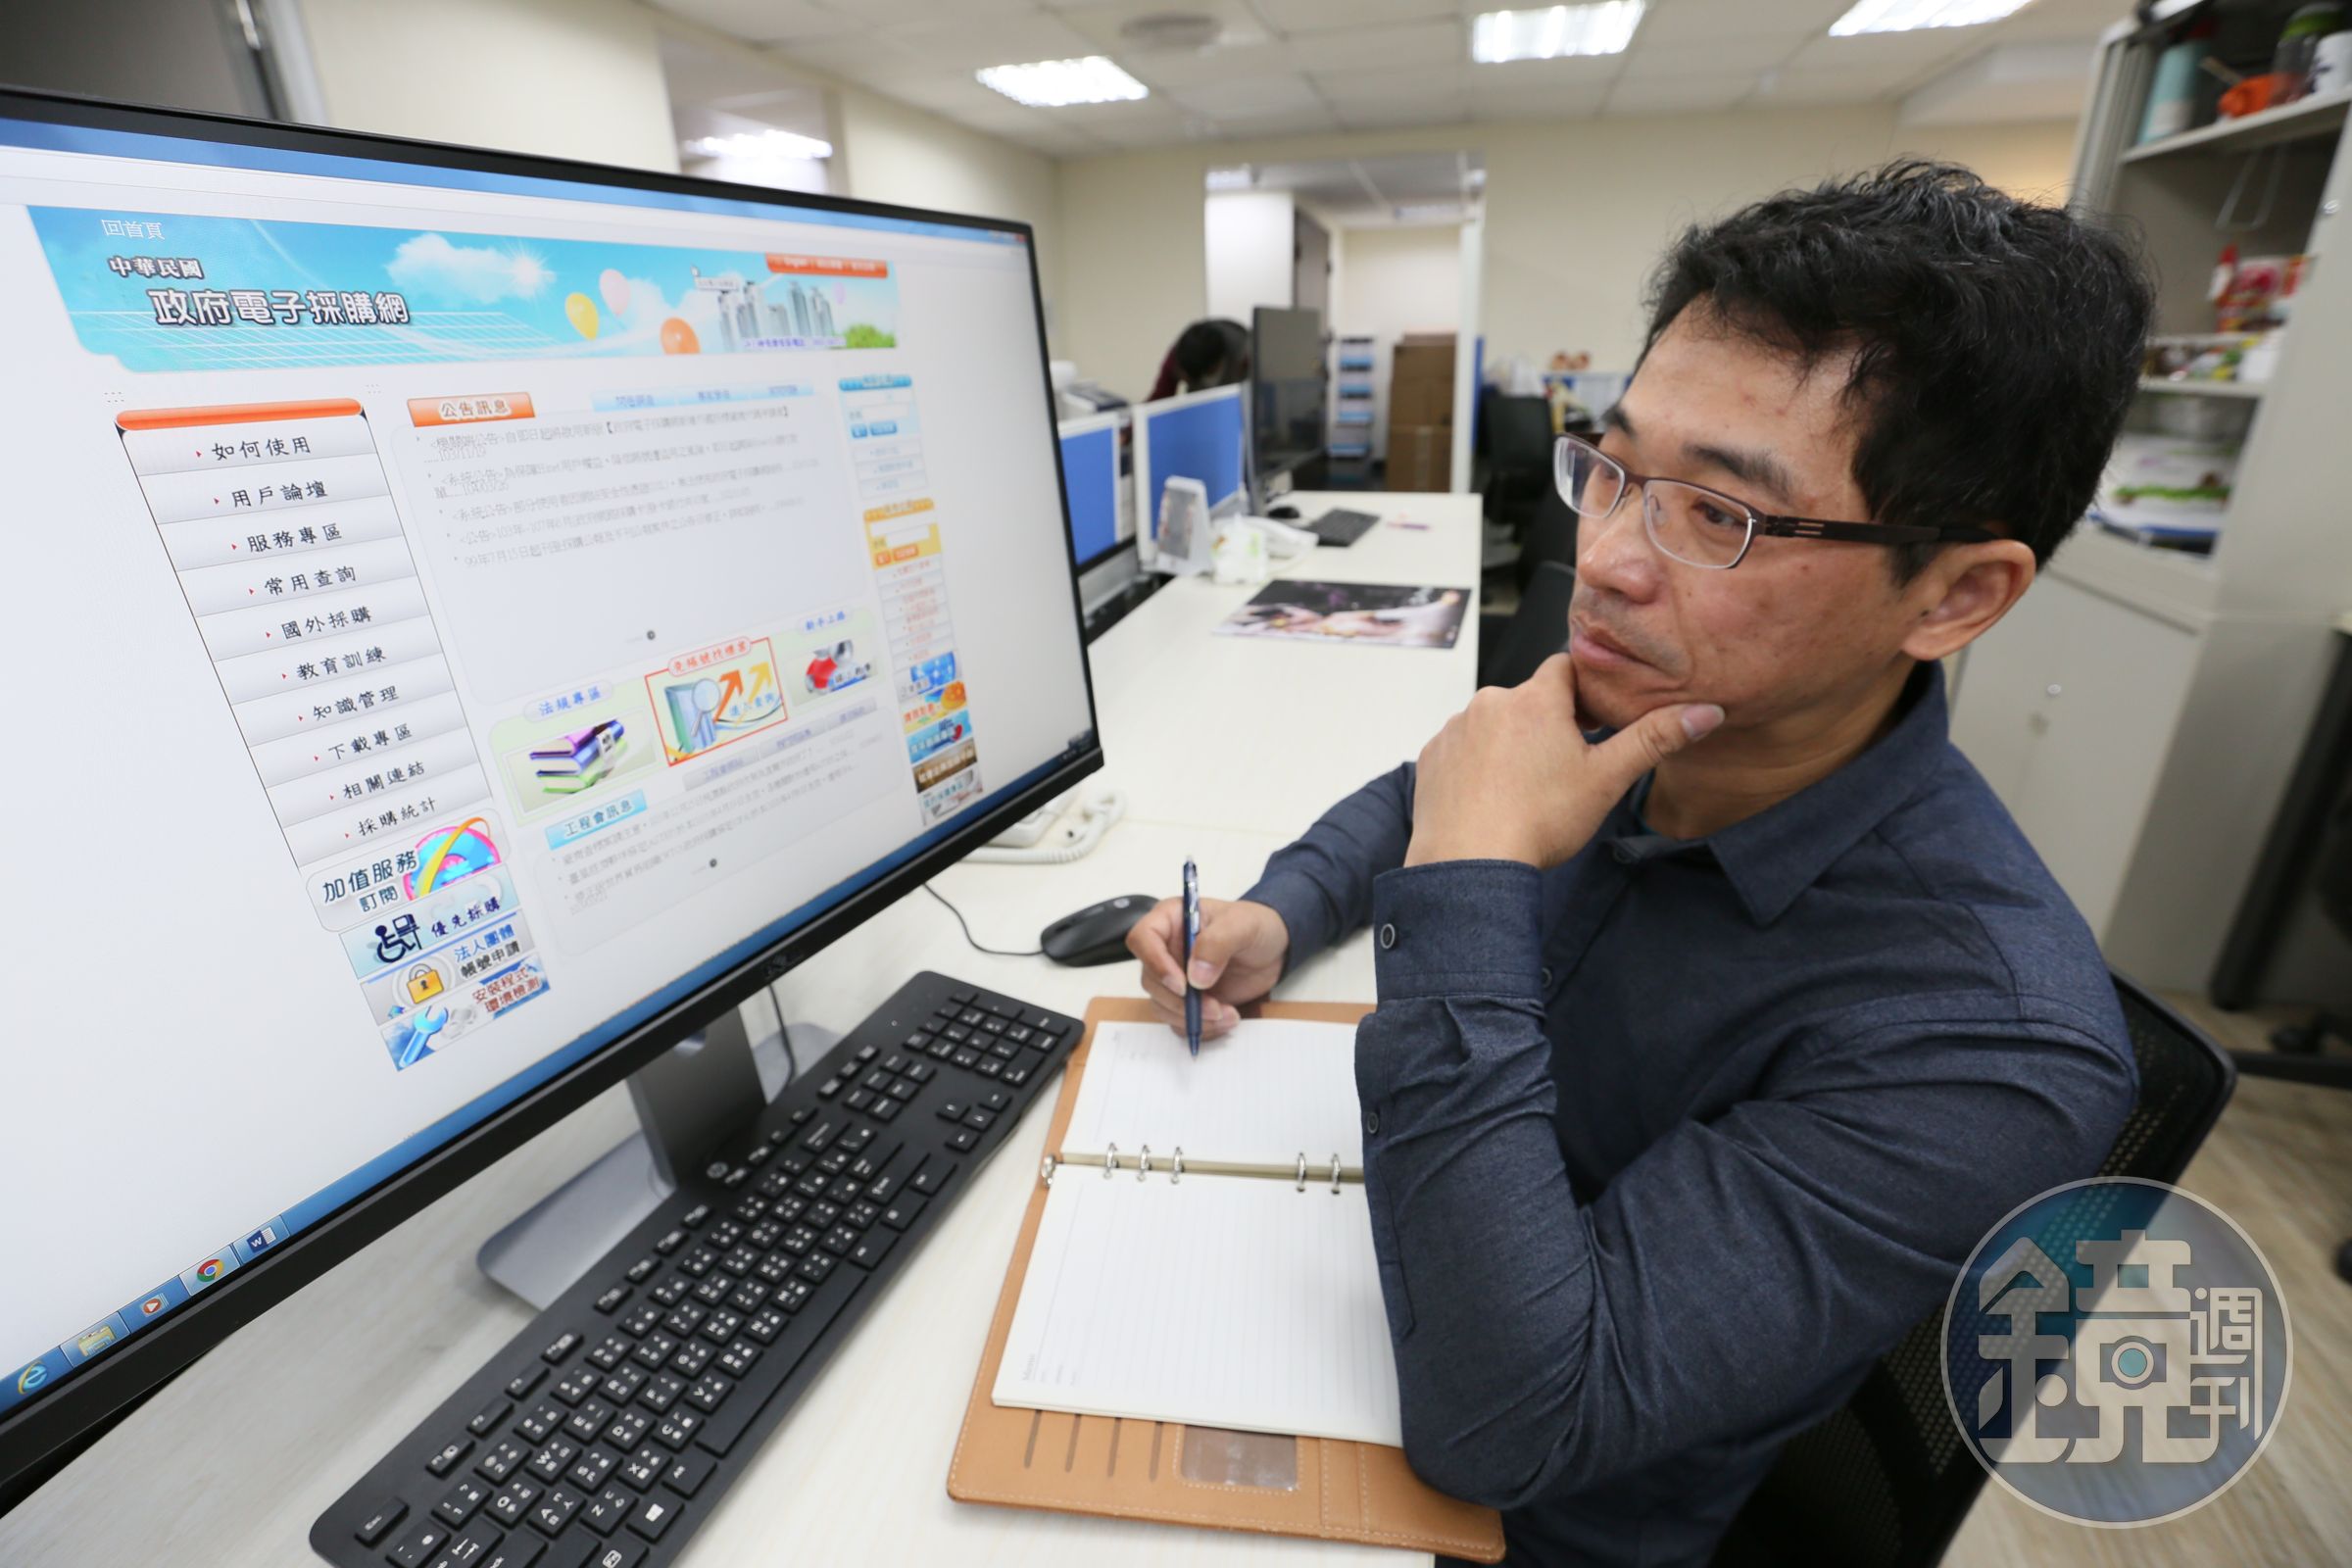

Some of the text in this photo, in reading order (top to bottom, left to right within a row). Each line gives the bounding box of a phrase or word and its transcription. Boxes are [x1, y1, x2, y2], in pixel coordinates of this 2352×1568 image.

[102, 220, 165, 241] 回首頁
[109, 256, 205, 279] 中華民國
[147, 288, 411, 325] 政府電子採購網
[441, 399, 509, 417] 公告訊息
[211, 436, 311, 461] 如何使用
[231, 479, 328, 509] 用戶論壇
[247, 523, 343, 554] 服務專區
[264, 564, 357, 597] 常用查詢
[281, 606, 372, 640] 國外採購
[296, 645, 387, 681] 教育訓練
[313, 685, 400, 721] 知識管理
[328, 723, 413, 761] 下載專區
[343, 760, 425, 800] 相關連結
[358, 797, 436, 837] 採購統計
[564, 799, 633, 838] 工程會訊息
[322, 850, 418, 904] 加值服務
[359, 885, 399, 913] 訂閱
[431, 896, 502, 938] 優先採購
[472, 965, 529, 1004] 安裝程式
